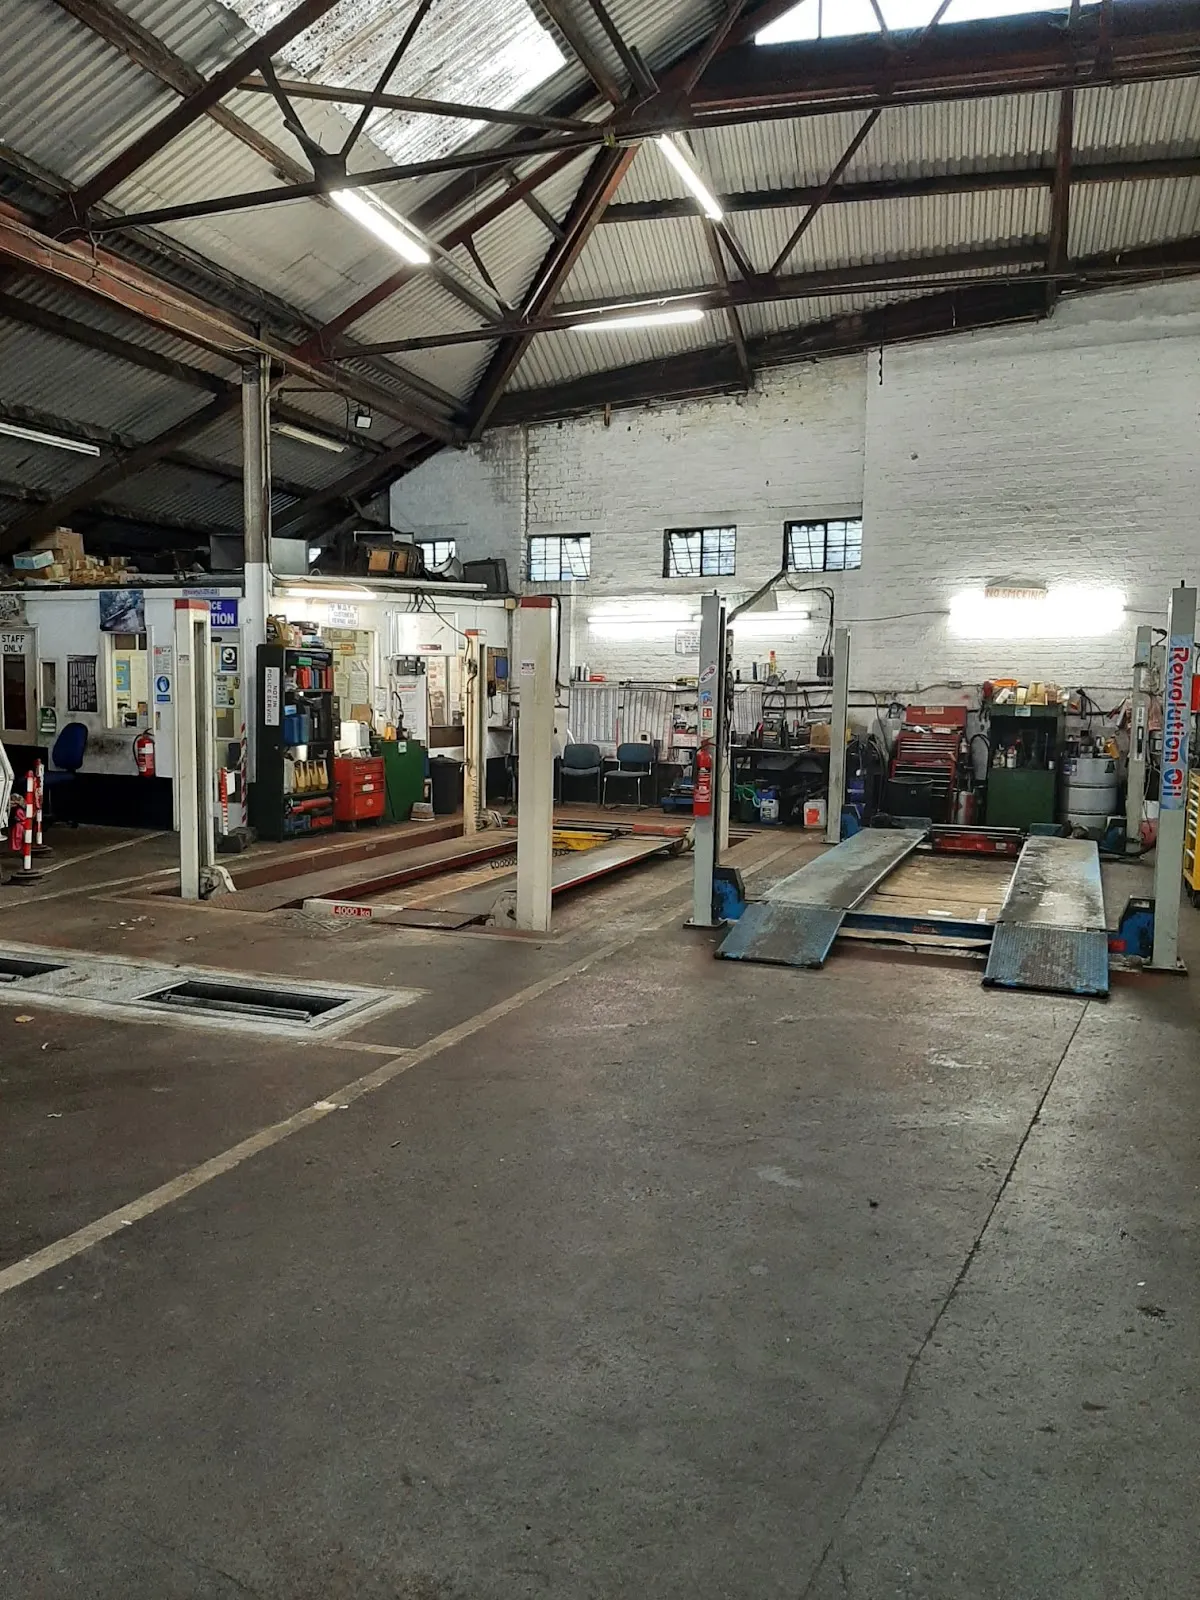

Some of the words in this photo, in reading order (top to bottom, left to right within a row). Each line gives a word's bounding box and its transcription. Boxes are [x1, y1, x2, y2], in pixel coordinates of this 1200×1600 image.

[1, 634, 25, 643] STAFF
[3, 644, 23, 652] ONLY
[272, 700, 278, 708] IN
[1165, 648, 1189, 762] Revolution
[1162, 769, 1183, 796] Oil
[335, 906, 358, 916] 4000
